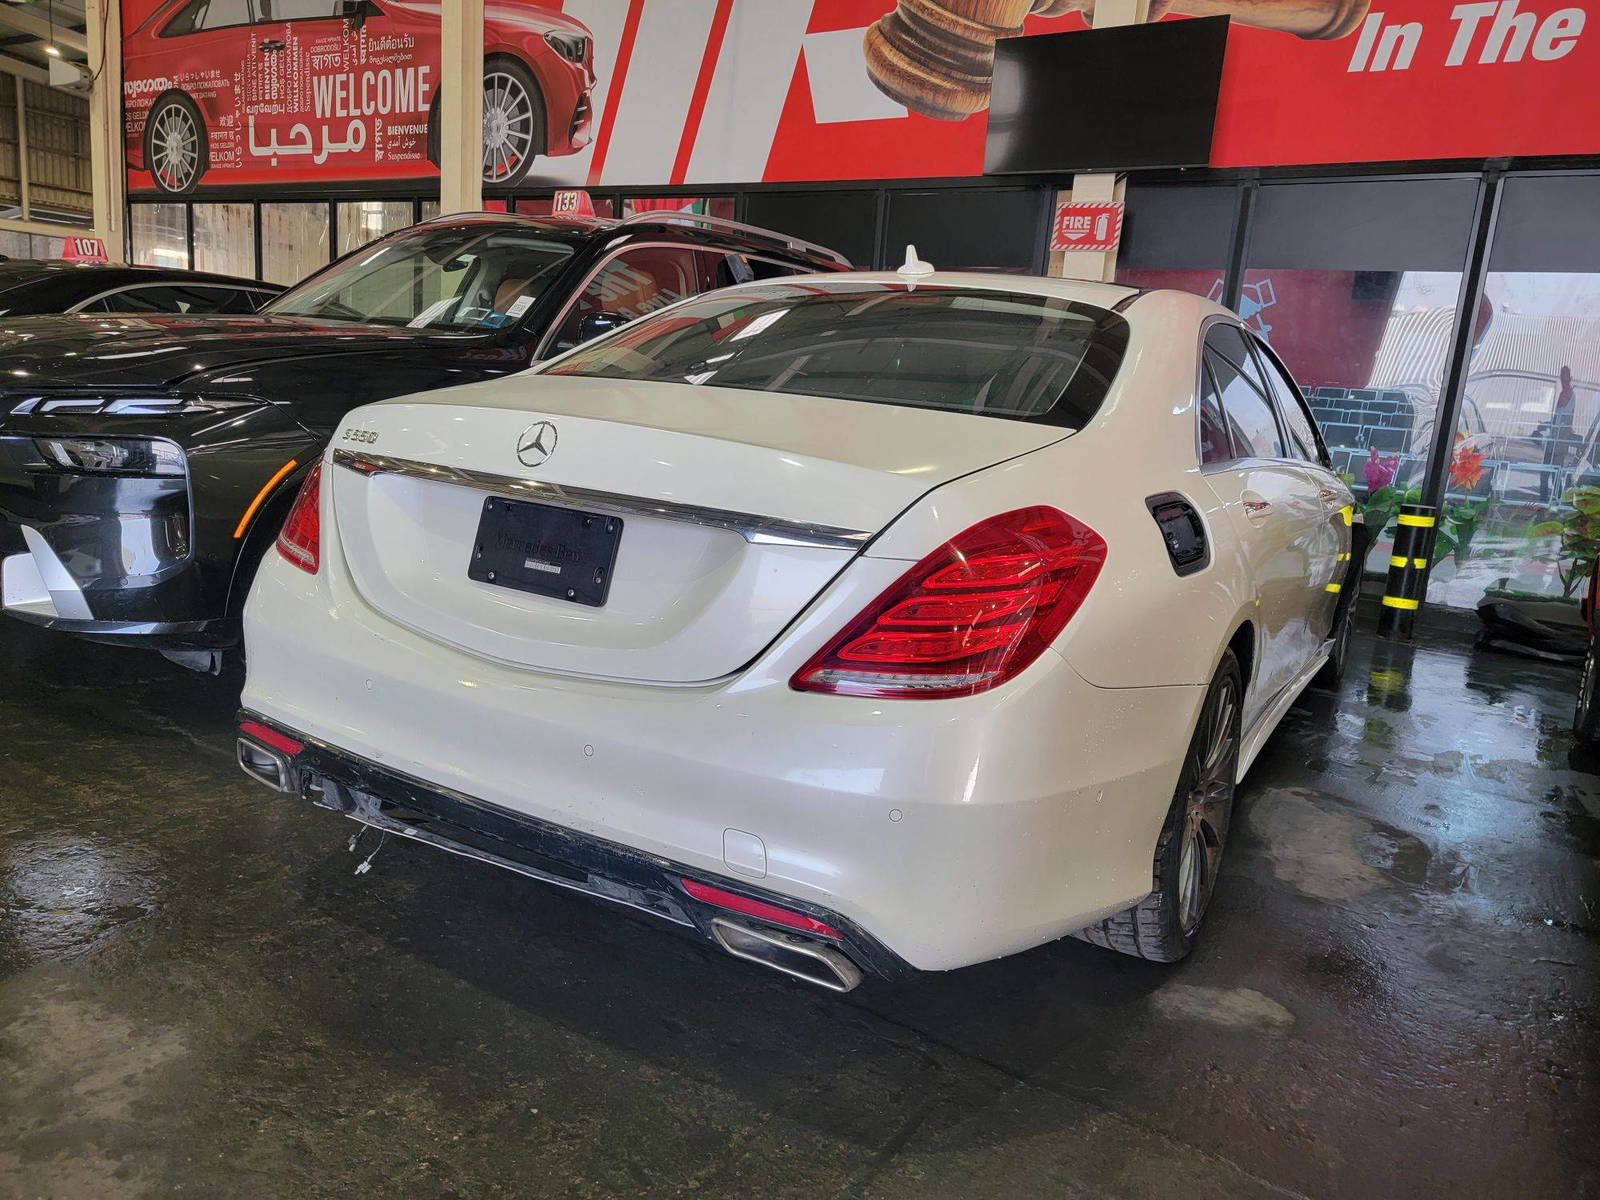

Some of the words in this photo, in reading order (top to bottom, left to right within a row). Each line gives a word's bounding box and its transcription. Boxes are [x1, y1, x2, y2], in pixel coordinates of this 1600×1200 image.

[1346, 12, 1424, 73] In
[1444, 0, 1587, 67] The
[312, 65, 430, 119] WELCOME
[387, 124, 428, 136] BIENVENUE
[248, 114, 367, 167] مرحبا
[557, 192, 578, 211] 133
[1062, 216, 1092, 229] FIRE
[75, 238, 98, 256] 107
